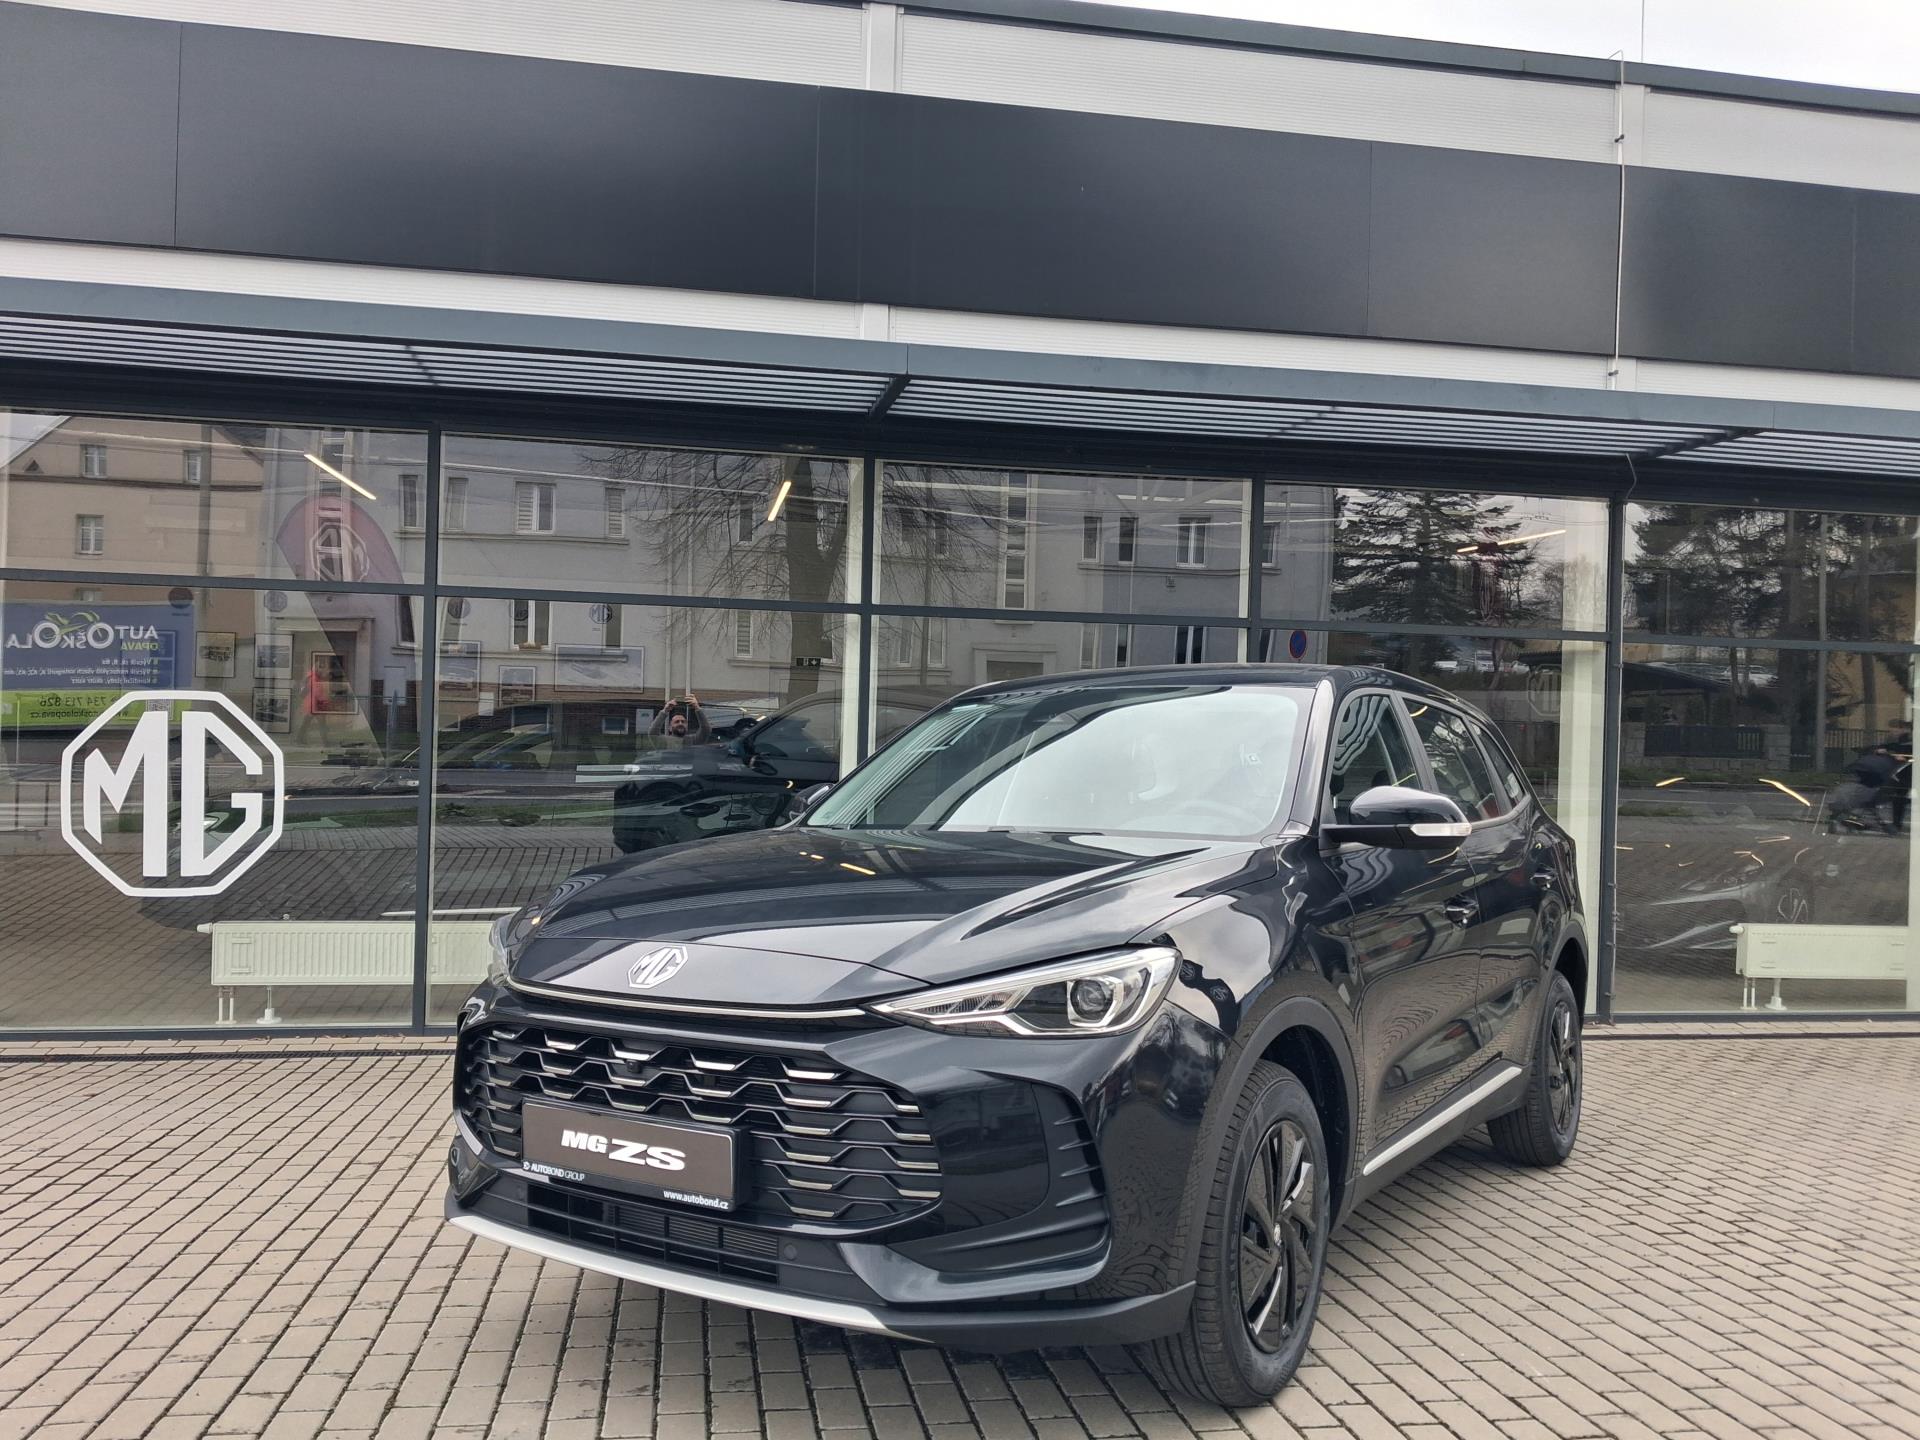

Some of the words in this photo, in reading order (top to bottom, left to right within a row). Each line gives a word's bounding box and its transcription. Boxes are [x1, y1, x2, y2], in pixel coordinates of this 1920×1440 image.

[84, 711, 263, 877] MG
[632, 948, 684, 985] MG
[561, 1130, 608, 1154] MG
[608, 1138, 686, 1171] ZS
[531, 1163, 564, 1178] AUTOBOND
[565, 1170, 585, 1182] GROUP
[663, 1190, 729, 1210] www.autobond.cz
